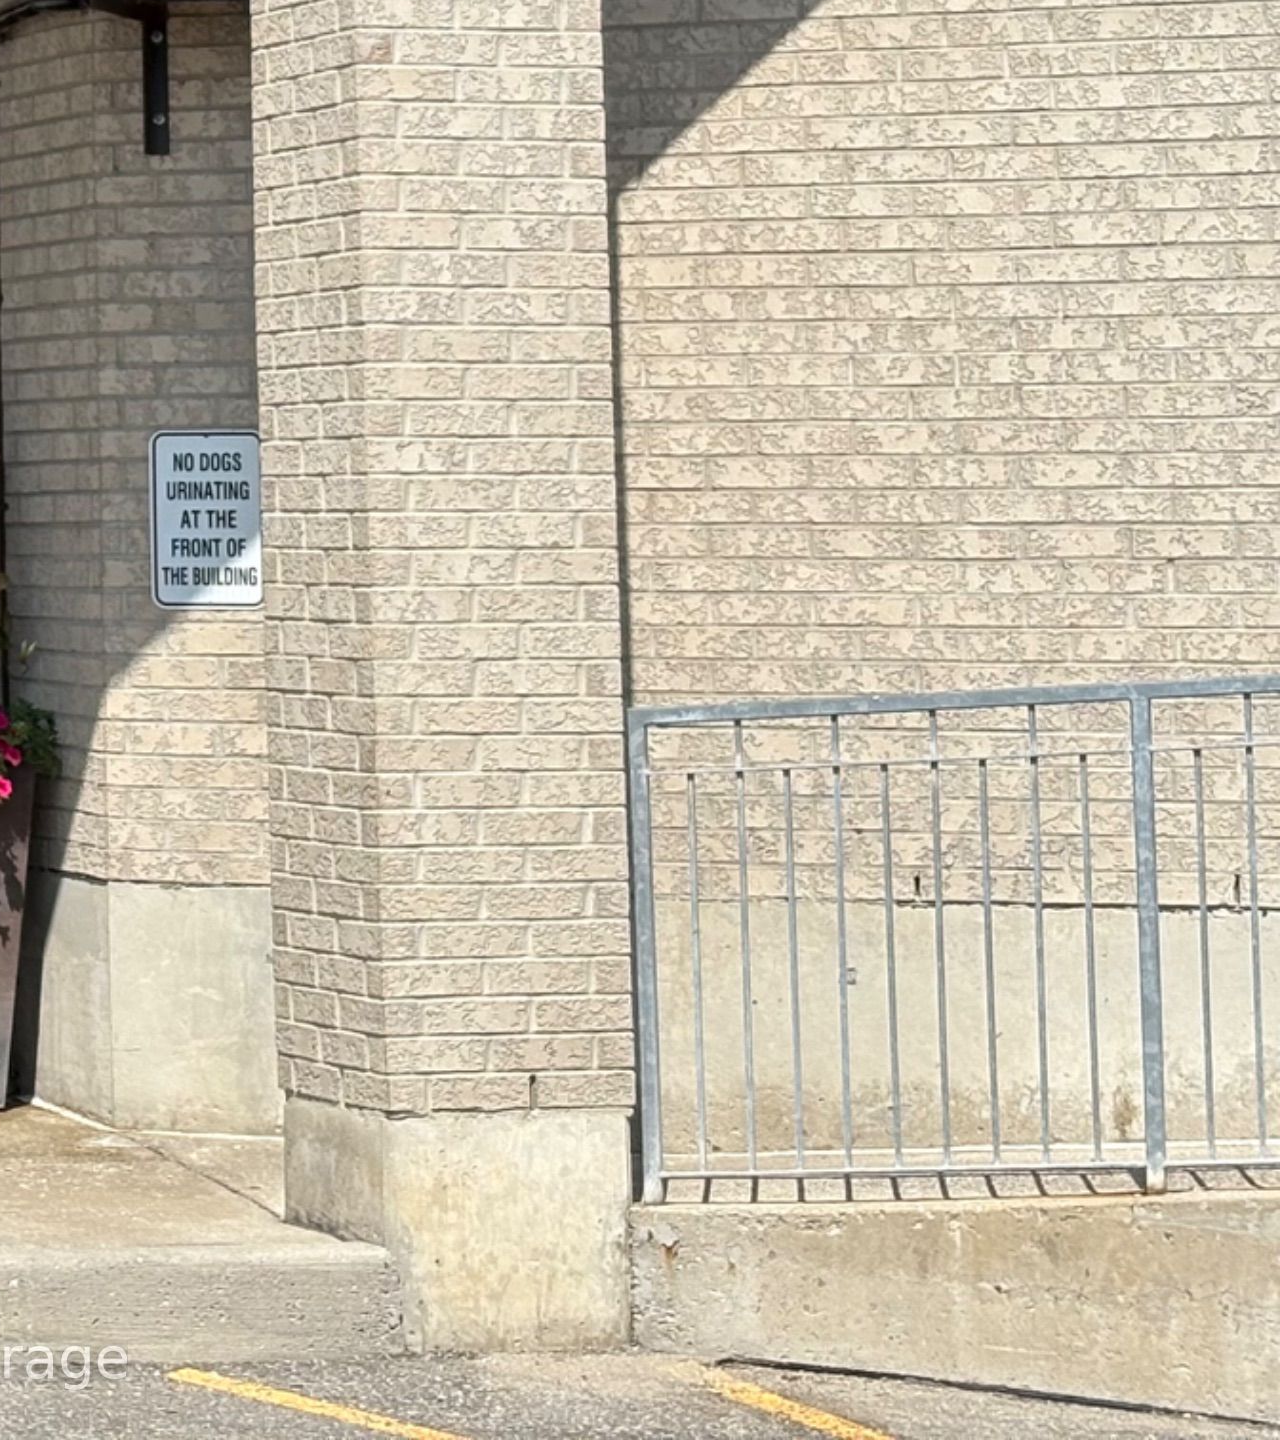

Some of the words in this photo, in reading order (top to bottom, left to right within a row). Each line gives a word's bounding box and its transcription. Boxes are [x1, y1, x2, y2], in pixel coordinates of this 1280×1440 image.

[173, 453, 194, 472] NO
[199, 453, 242, 472] DOGS
[166, 481, 250, 501] URINATING
[180, 510, 200, 529] AT
[207, 510, 237, 529] THE
[171, 538, 221, 558] FRONT
[226, 538, 246, 558] OF
[161, 567, 188, 586] THE
[192, 567, 258, 586] BUILDING
